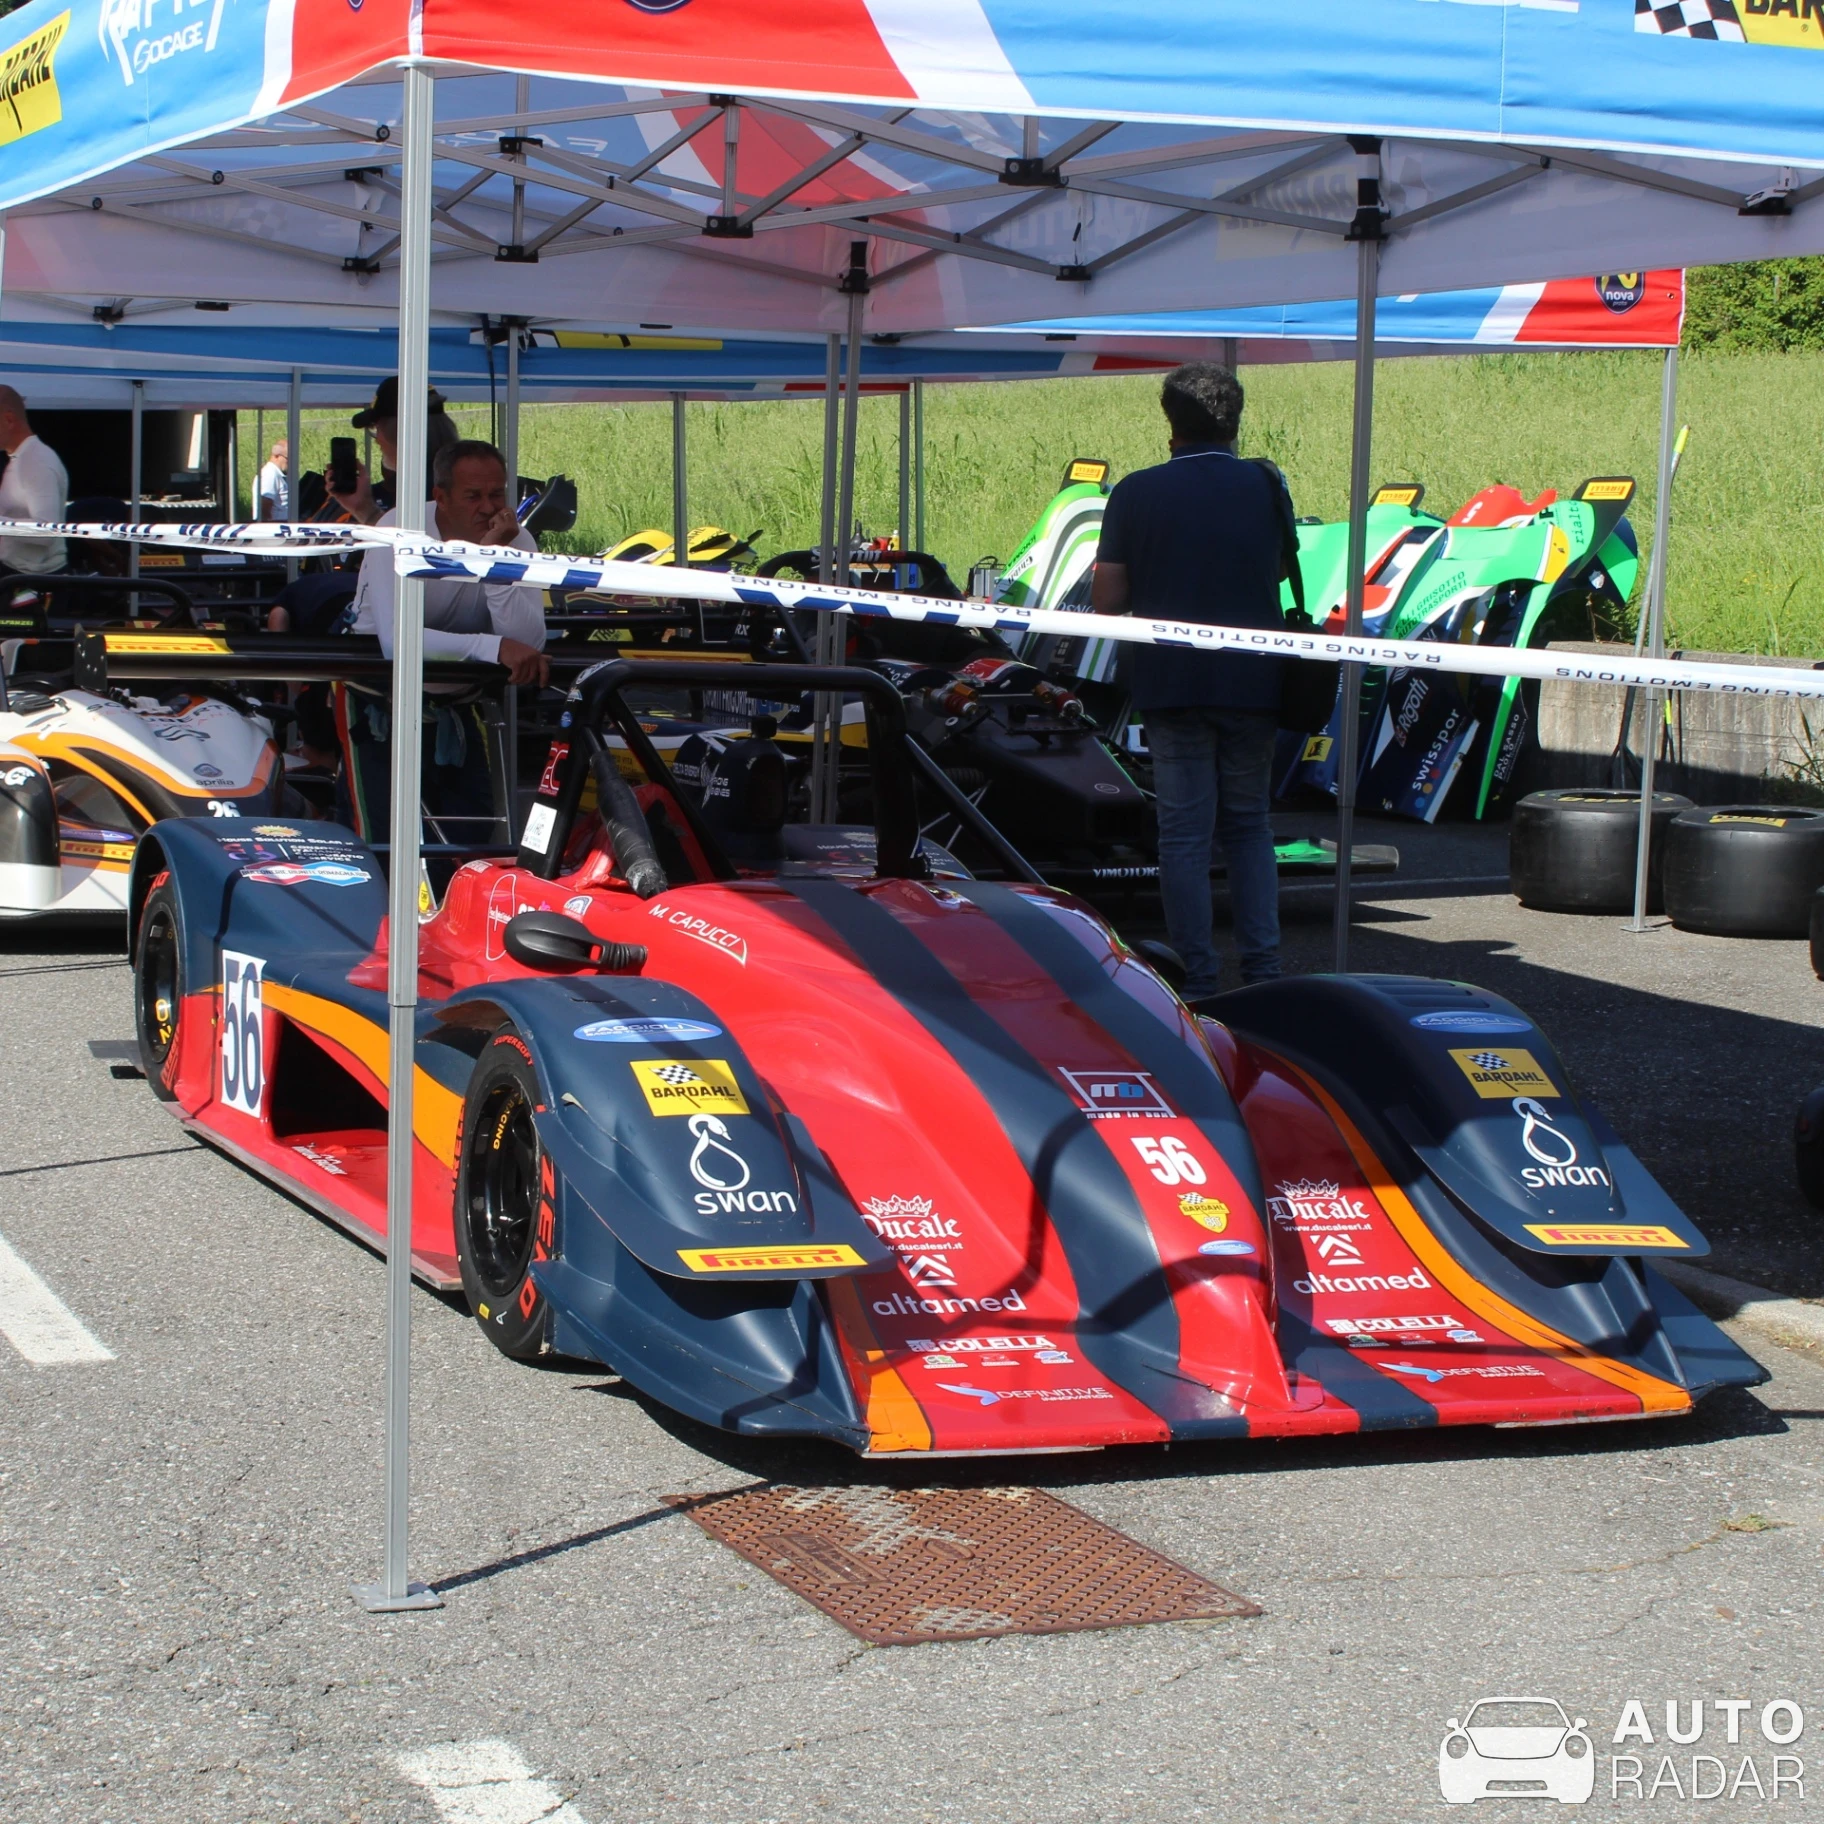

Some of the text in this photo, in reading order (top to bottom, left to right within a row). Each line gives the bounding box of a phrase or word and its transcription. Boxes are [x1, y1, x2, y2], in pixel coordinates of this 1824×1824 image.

[1606, 291, 1634, 301] nova
[1416, 570, 1466, 612] GRISOTTO
[1397, 579, 1468, 639] AUTOTRASPORTI
[1152, 624, 1441, 664] RACING EMOTIONS
[1556, 667, 1711, 690] EMOTIONS
[1397, 675, 1431, 735] Rigotti
[1411, 707, 1463, 792] swisspor
[1493, 756, 1505, 778] DAL
[1502, 713, 1520, 756] SASSO
[1497, 743, 1514, 780] PAOLO
[196, 778, 236, 787] aprilia
[307, 838, 342, 846] SOLAR
[648, 903, 742, 949] M. CAPUCCI
[224, 958, 261, 1110] 56
[582, 1023, 685, 1033] FAGGIOLI
[494, 1034, 534, 1067] SUPERSOFT
[1472, 1071, 1544, 1083] BARDAHL
[650, 1086, 736, 1098] BARDAHL
[1130, 1136, 1207, 1186] 56
[1521, 1166, 1609, 1188] swan
[694, 1190, 797, 1215] swan
[1182, 1202, 1226, 1213] BARDAHL
[1266, 1195, 1370, 1225] Ducale
[1282, 1223, 1373, 1232] www.ducalesrl.it
[1543, 1228, 1669, 1243] PIRELLI
[699, 1248, 845, 1268] PIRELLI
[1293, 1266, 1432, 1294] altamed
[873, 1288, 1027, 1315] altamed
[1355, 1315, 1465, 1332] COLELLA
[938, 1335, 1057, 1352] COLELLA
[1436, 1365, 1538, 1377] DEFINITIVE
[996, 1387, 1110, 1399] DEFINITIVE
